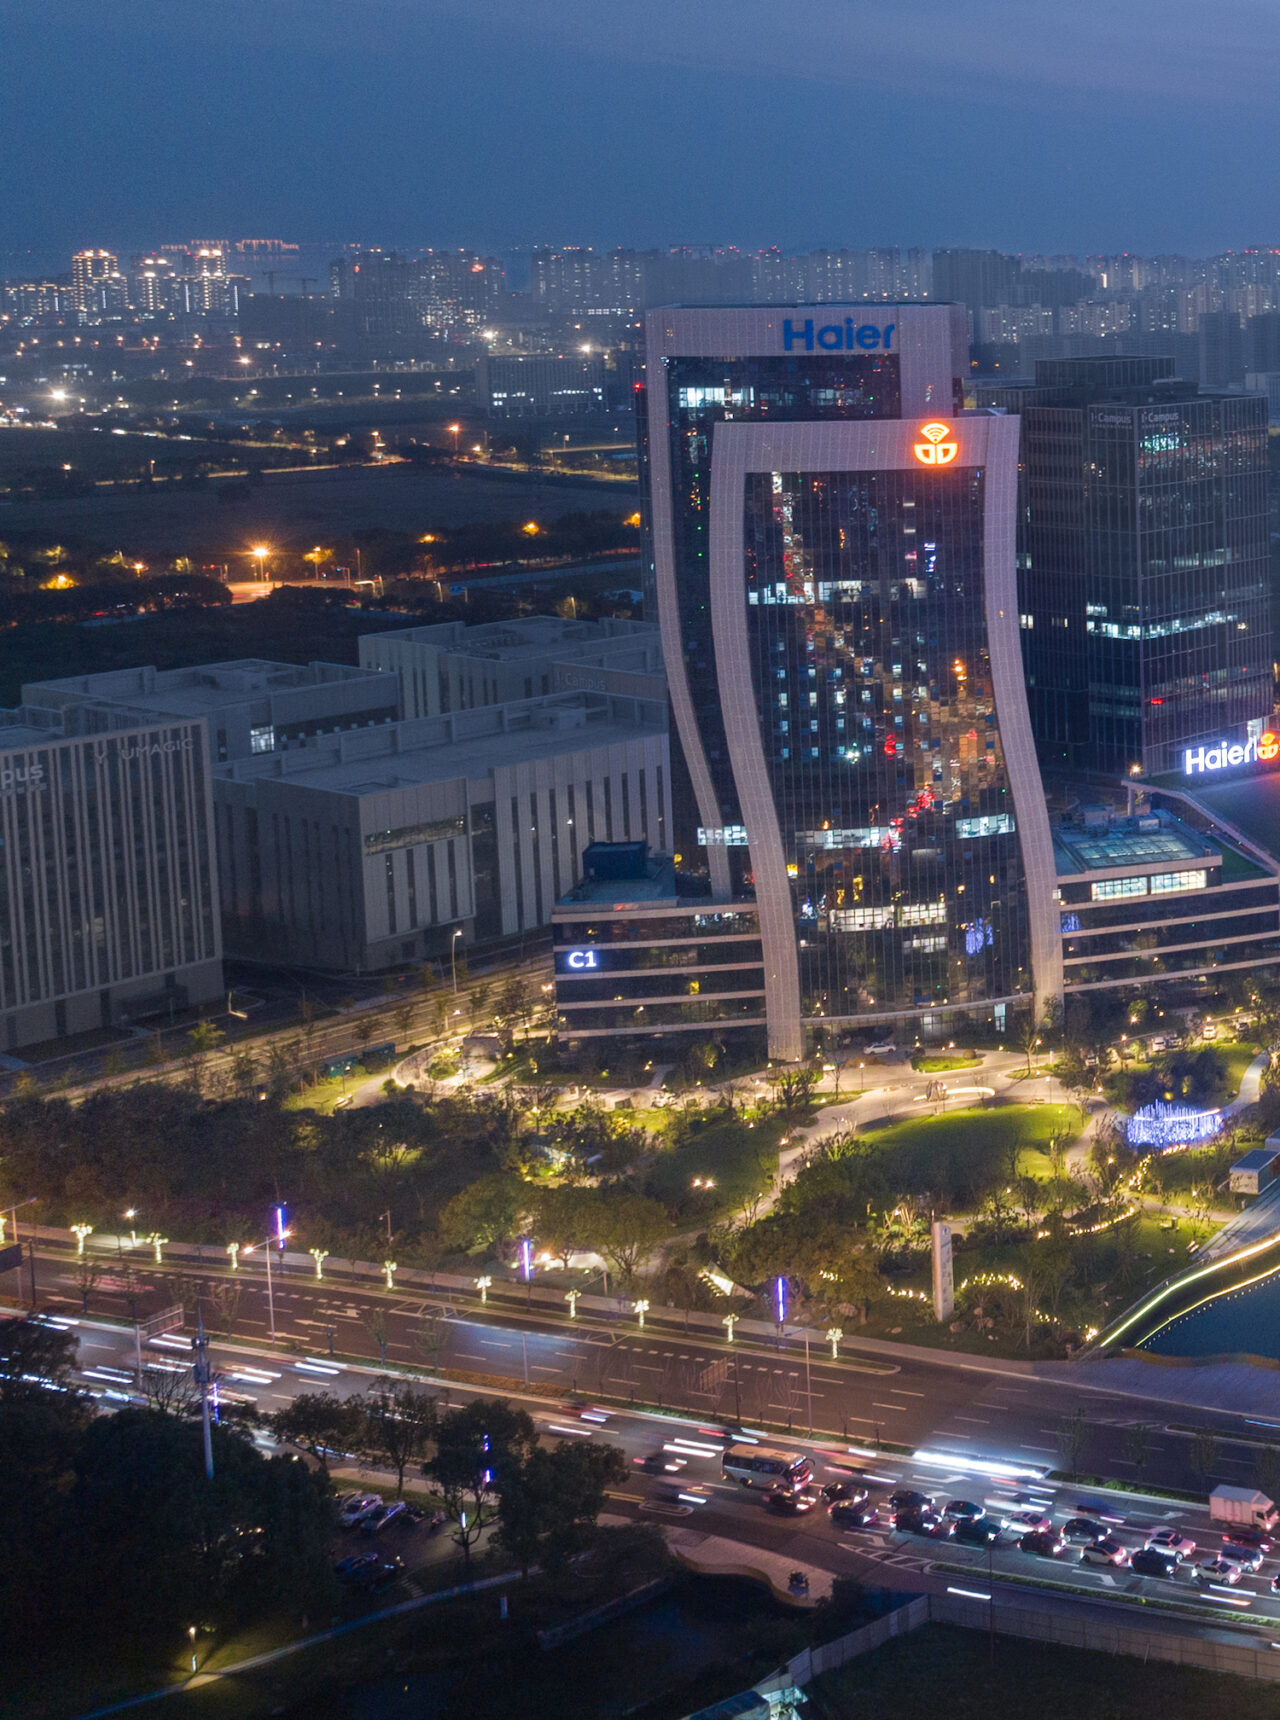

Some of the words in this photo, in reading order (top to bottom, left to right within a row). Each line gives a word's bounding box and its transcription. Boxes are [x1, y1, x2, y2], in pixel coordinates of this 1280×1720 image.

[783, 317, 896, 351] Haier
[120, 738, 194, 760] UMAGIC
[1185, 740, 1254, 775] Haier
[568, 950, 597, 968] C1
